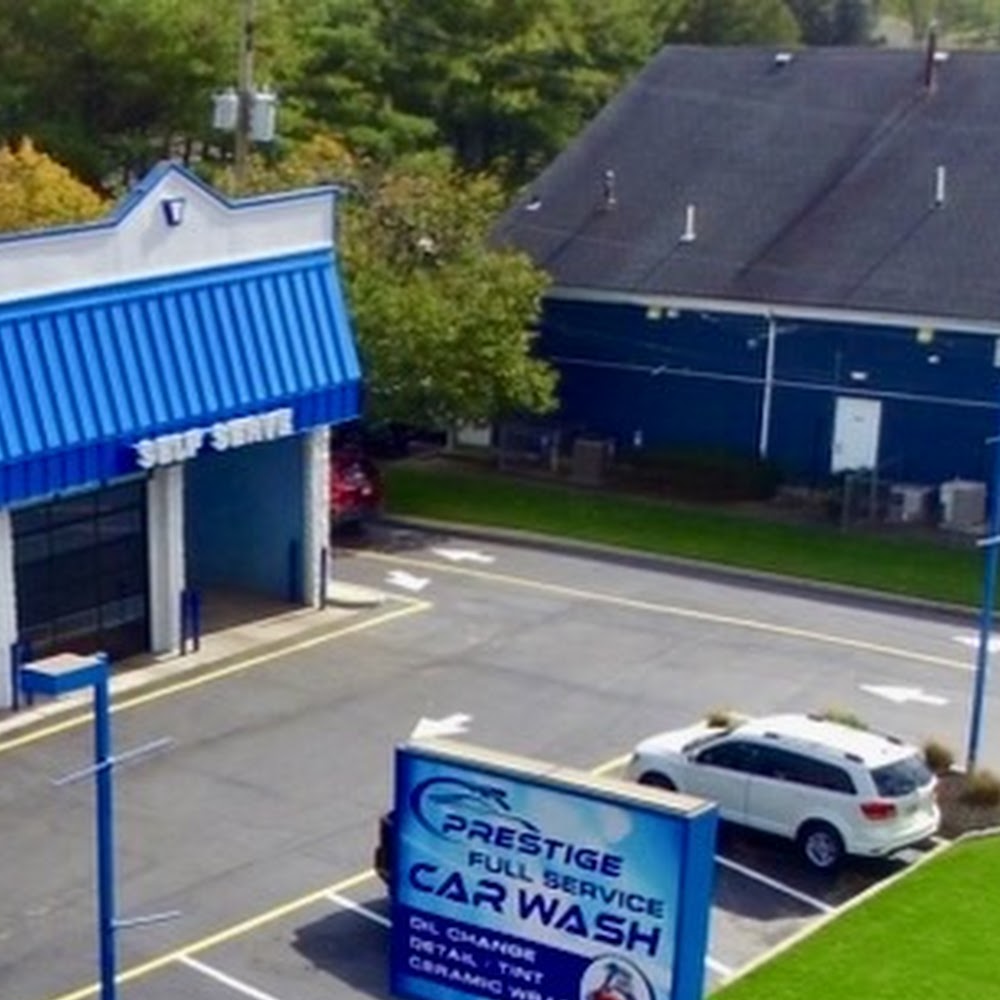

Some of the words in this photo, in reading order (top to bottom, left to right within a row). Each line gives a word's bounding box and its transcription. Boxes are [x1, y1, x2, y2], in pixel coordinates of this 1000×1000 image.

[442, 813, 624, 878] PRESTIGE
[409, 862, 507, 914] CAR
[518, 888, 662, 957] WASH
[468, 850, 534, 883] FULL
[543, 869, 665, 919] SERVICE
[409, 916, 440, 936] OIL
[446, 927, 537, 963] CHANGE
[409, 936, 478, 967] DETAIL
[498, 961, 544, 984] TINT
[408, 955, 503, 995] CERAMIC
